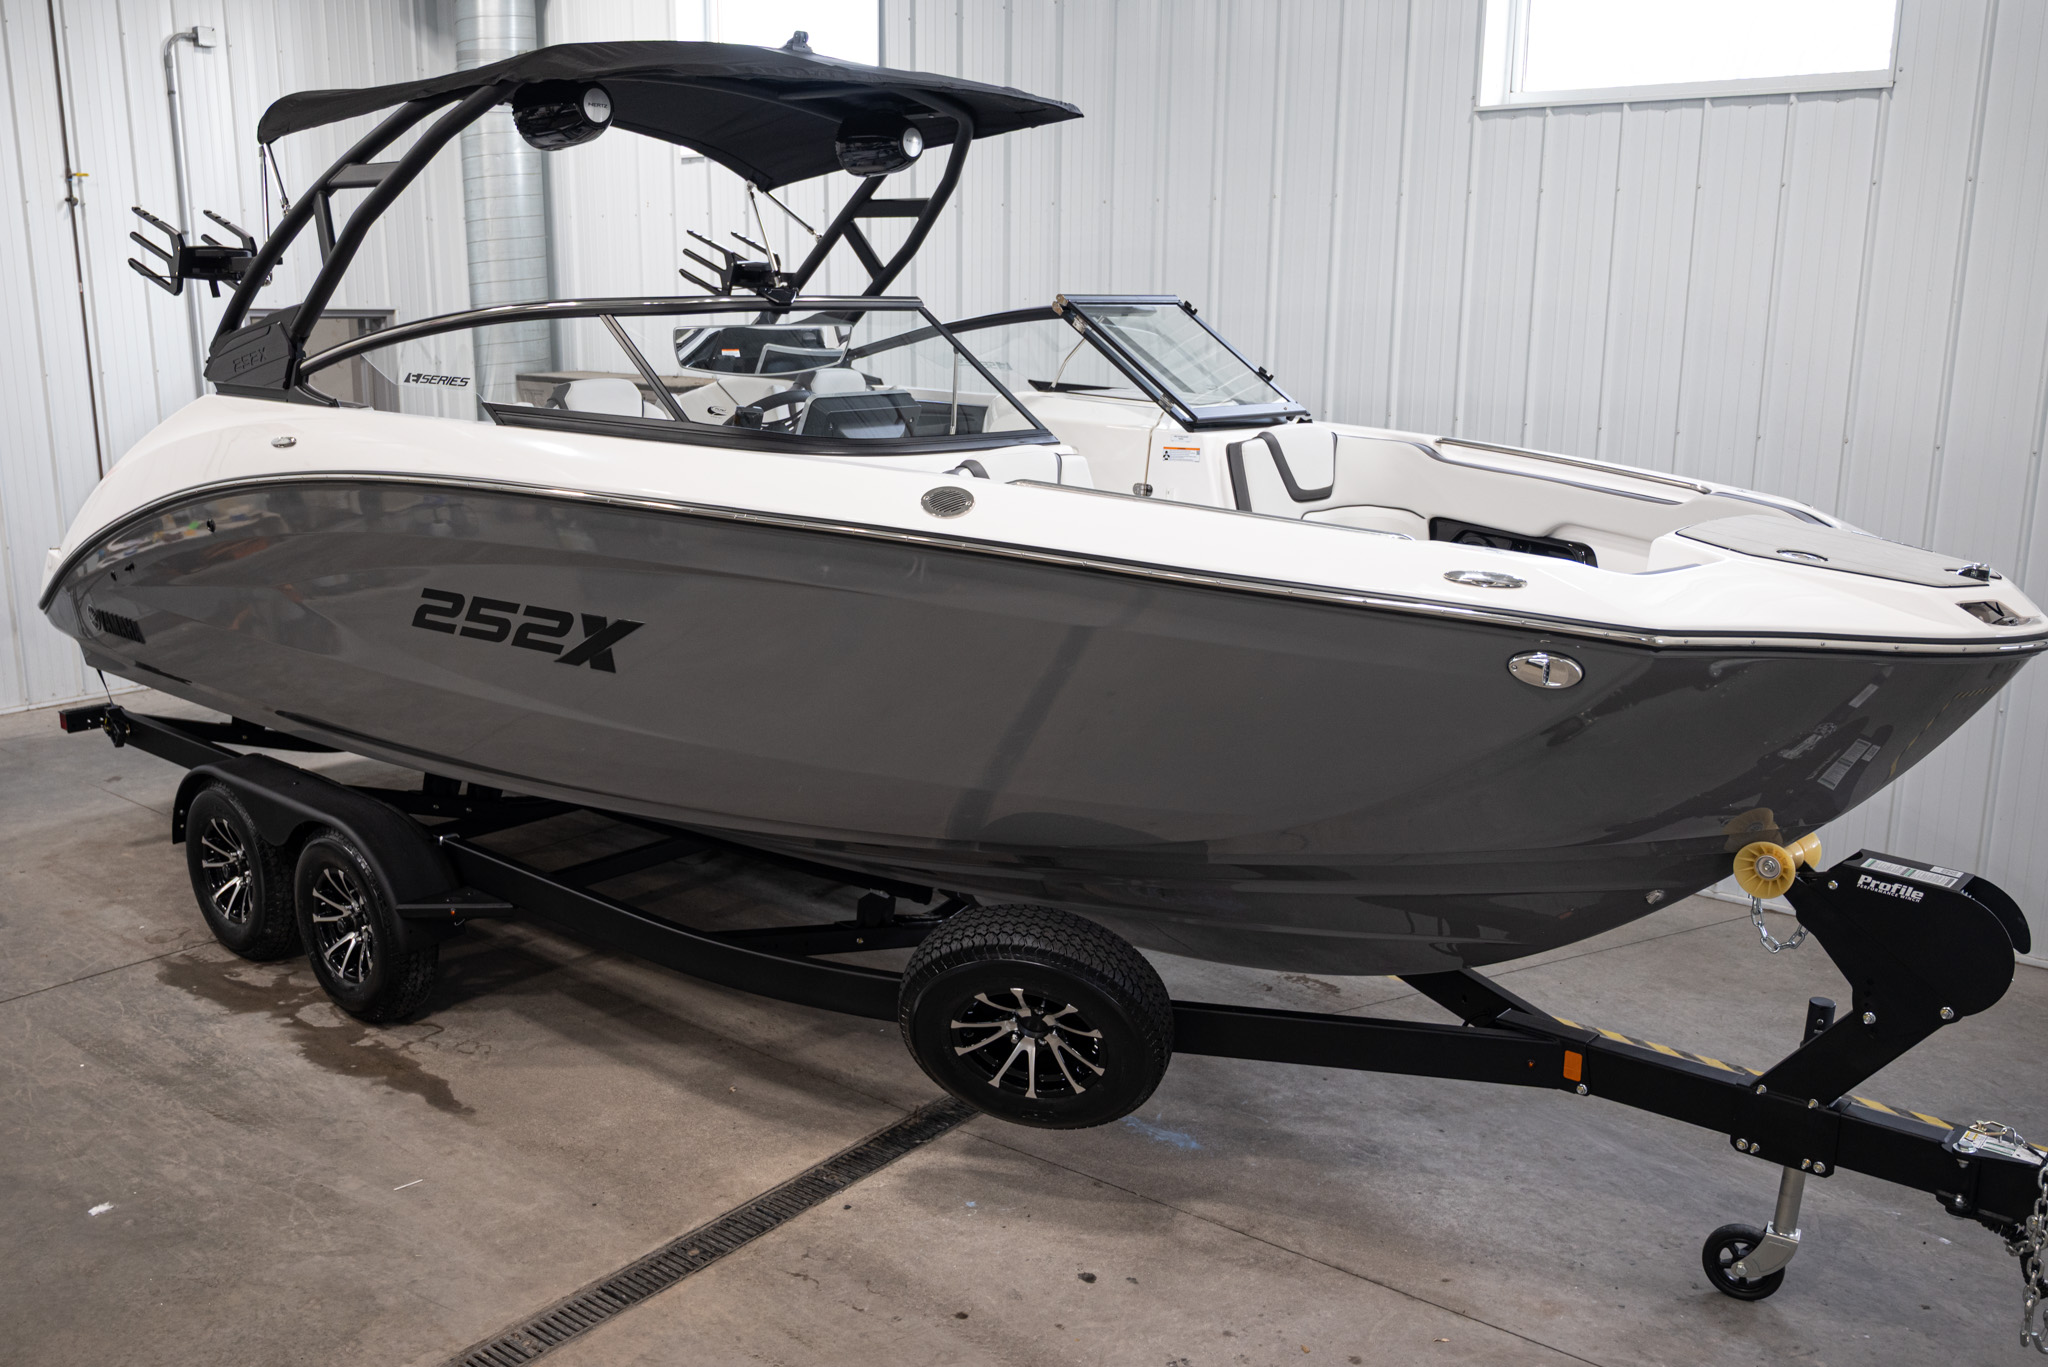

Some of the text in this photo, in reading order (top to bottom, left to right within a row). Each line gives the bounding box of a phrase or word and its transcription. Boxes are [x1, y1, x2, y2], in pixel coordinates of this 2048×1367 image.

[419, 374, 471, 387] SERIES
[411, 587, 646, 674] 252X
[1856, 884, 1922, 903] PERFORMANCE WINCH
[1857, 874, 1925, 899] Profile
